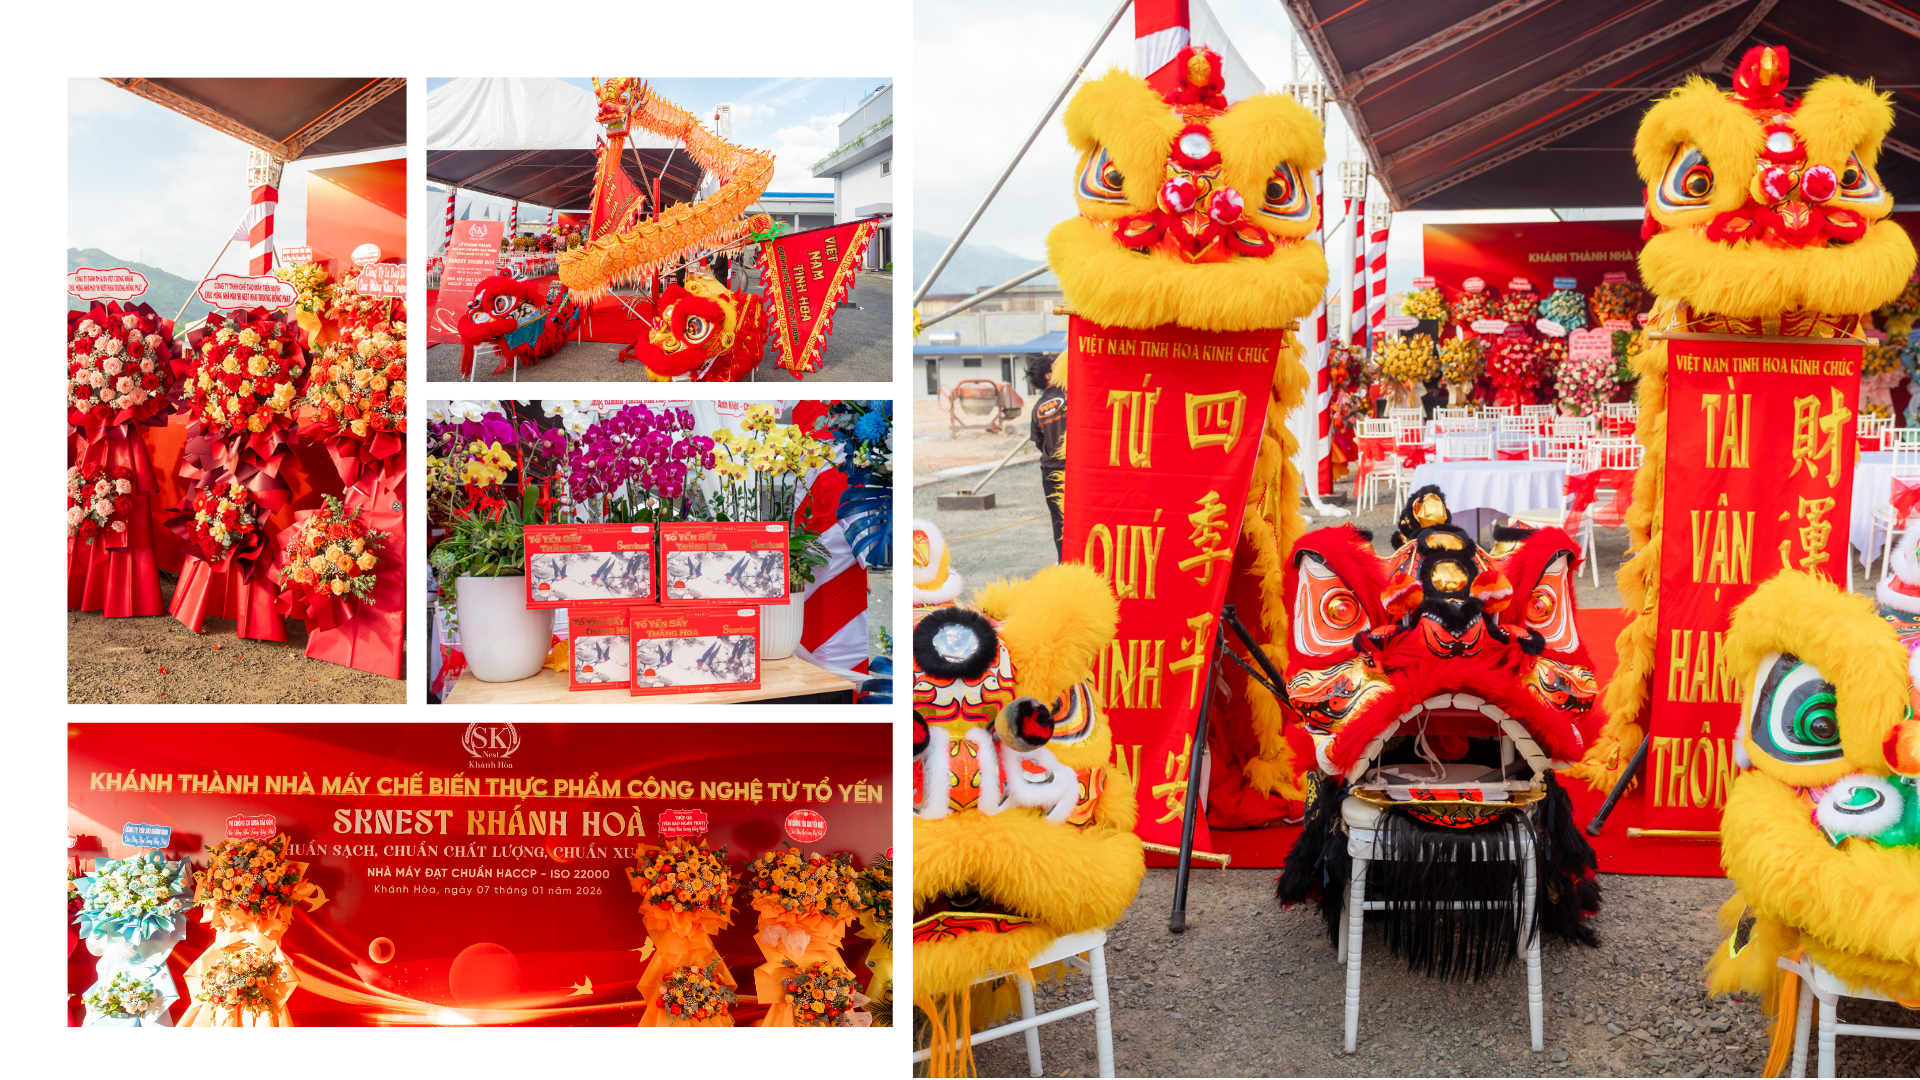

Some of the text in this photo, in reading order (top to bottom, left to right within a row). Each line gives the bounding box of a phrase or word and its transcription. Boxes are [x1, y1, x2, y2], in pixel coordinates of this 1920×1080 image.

[605, 182, 617, 207] NAM
[593, 218, 612, 238] TINH
[777, 246, 787, 264] ĐOÀN
[824, 235, 840, 262] VIỆT
[1528, 249, 1633, 262] KHÁNH THÀNH NHÀ
[365, 266, 377, 279] Công
[378, 267, 384, 279] Ty
[781, 265, 791, 283] NGHỆ
[808, 250, 825, 281] NAM
[214, 281, 224, 289] CÔNG
[792, 264, 812, 322] TINH HOA
[788, 304, 796, 316] LÂN
[791, 327, 801, 345] RỒNG
[1078, 333, 1270, 363] VIỆT NAM TINH HOA KÍNH CHÚC
[1676, 353, 1854, 376] VIỆT NAM TINH HOA KÍNH CHÚC
[718, 400, 728, 408] Anh
[729, 401, 739, 411] Kiệt
[1106, 373, 1162, 468] TỨ
[1700, 376, 1752, 468] TÀI
[1084, 508, 1166, 599] QUÝ
[1690, 492, 1756, 602] VẬN
[472, 726, 509, 749] SK
[482, 750, 499, 758] Nest
[498, 760, 513, 769] Hòa
[1652, 721, 1737, 809] THÔN
[90, 768, 883, 805] KHÁNH THÀNH NHÀ MÁY CHẾ BIẾN THỰC PHẨM CÔNG NGHỆ TỪ TỔ YẾN
[333, 804, 646, 837] SKNEST KHÁNH HOÀ
[285, 839, 634, 860] HUẨN SẠCH, CHUẨN CHẤT LƯỢNG, CHUẨN XU
[367, 865, 610, 880] NHÀ MÁY ĐẠT CHUẨN HACCP ISO 22000
[374, 885, 602, 896] Khánh Hòa, ngày 07 tháng 01 năm 2026
